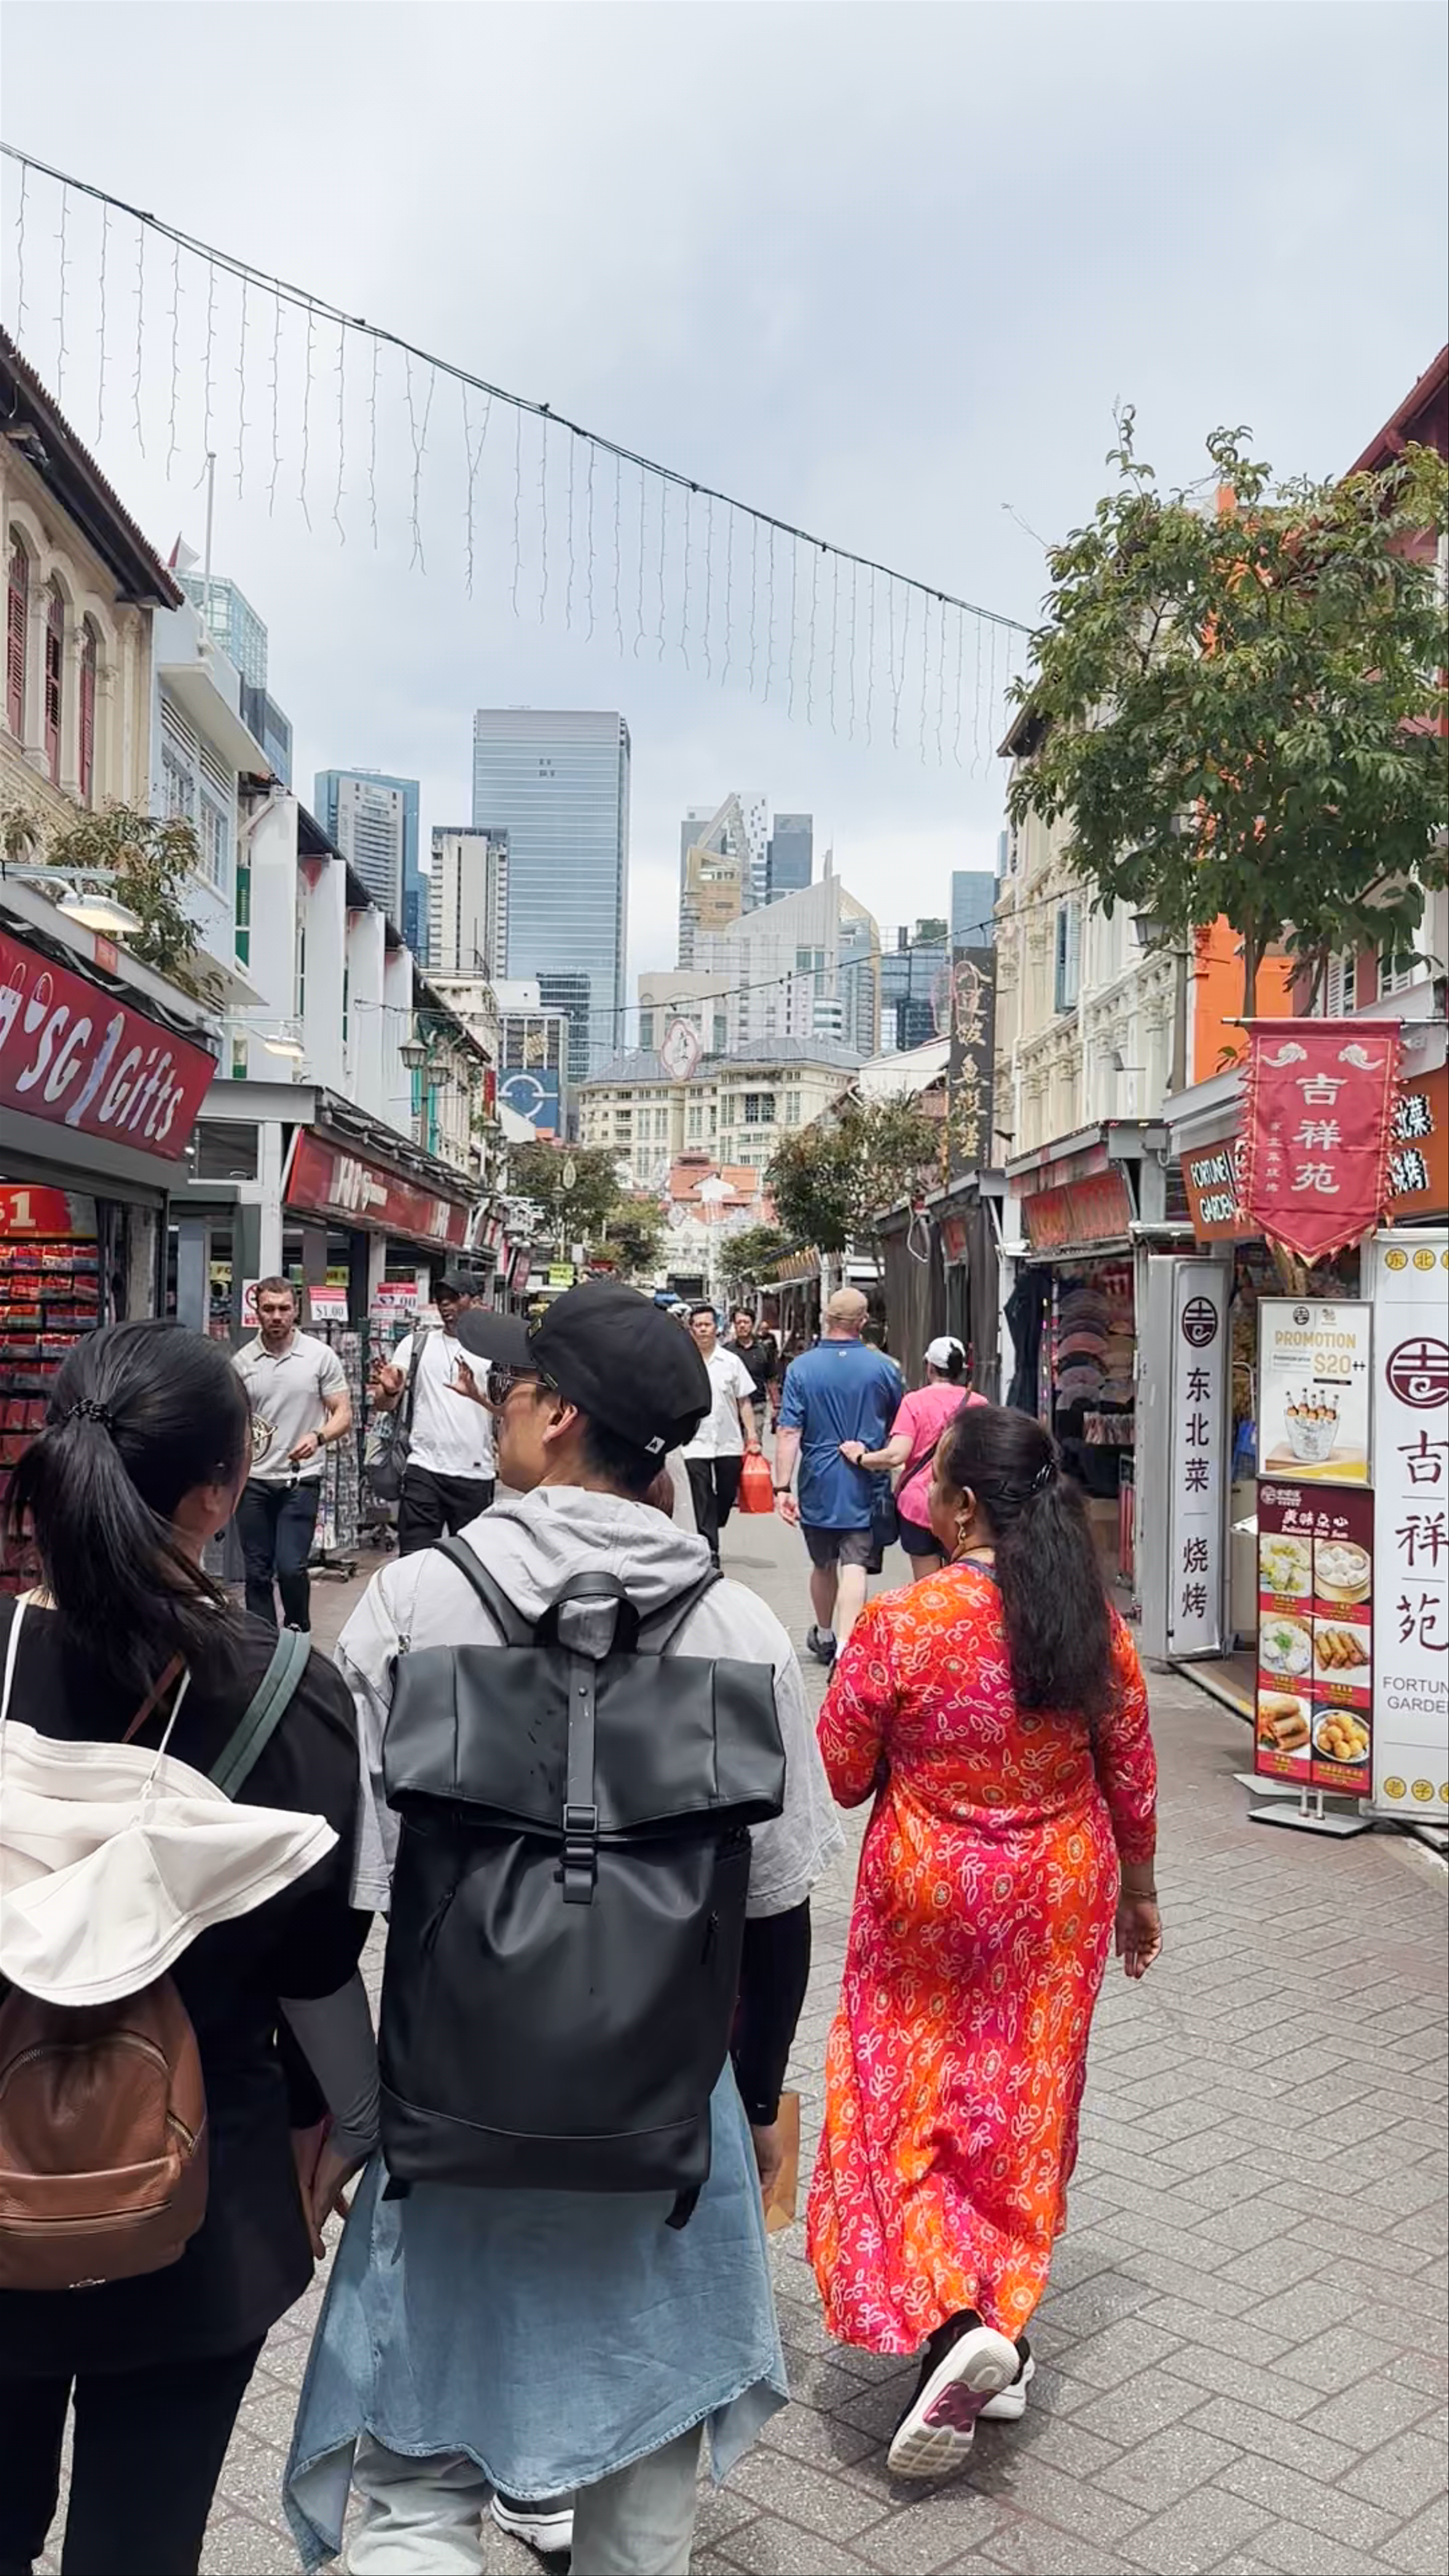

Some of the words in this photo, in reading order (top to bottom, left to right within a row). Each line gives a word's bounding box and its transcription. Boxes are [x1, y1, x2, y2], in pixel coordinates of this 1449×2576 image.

[98, 1046, 184, 1141] Gifts
[1291, 1073, 1348, 1193] 吉祥苑
[1190, 1155, 1227, 1189] FORTUNE
[1275, 1330, 1356, 1349] PROMOTION
[1185, 1367, 1211, 1493] 东北菜
[1182, 1537, 1208, 1619] 烧烤
[1396, 1429, 1448, 1651] 吉祥苑
[1387, 1696, 1446, 1713] GARDE
